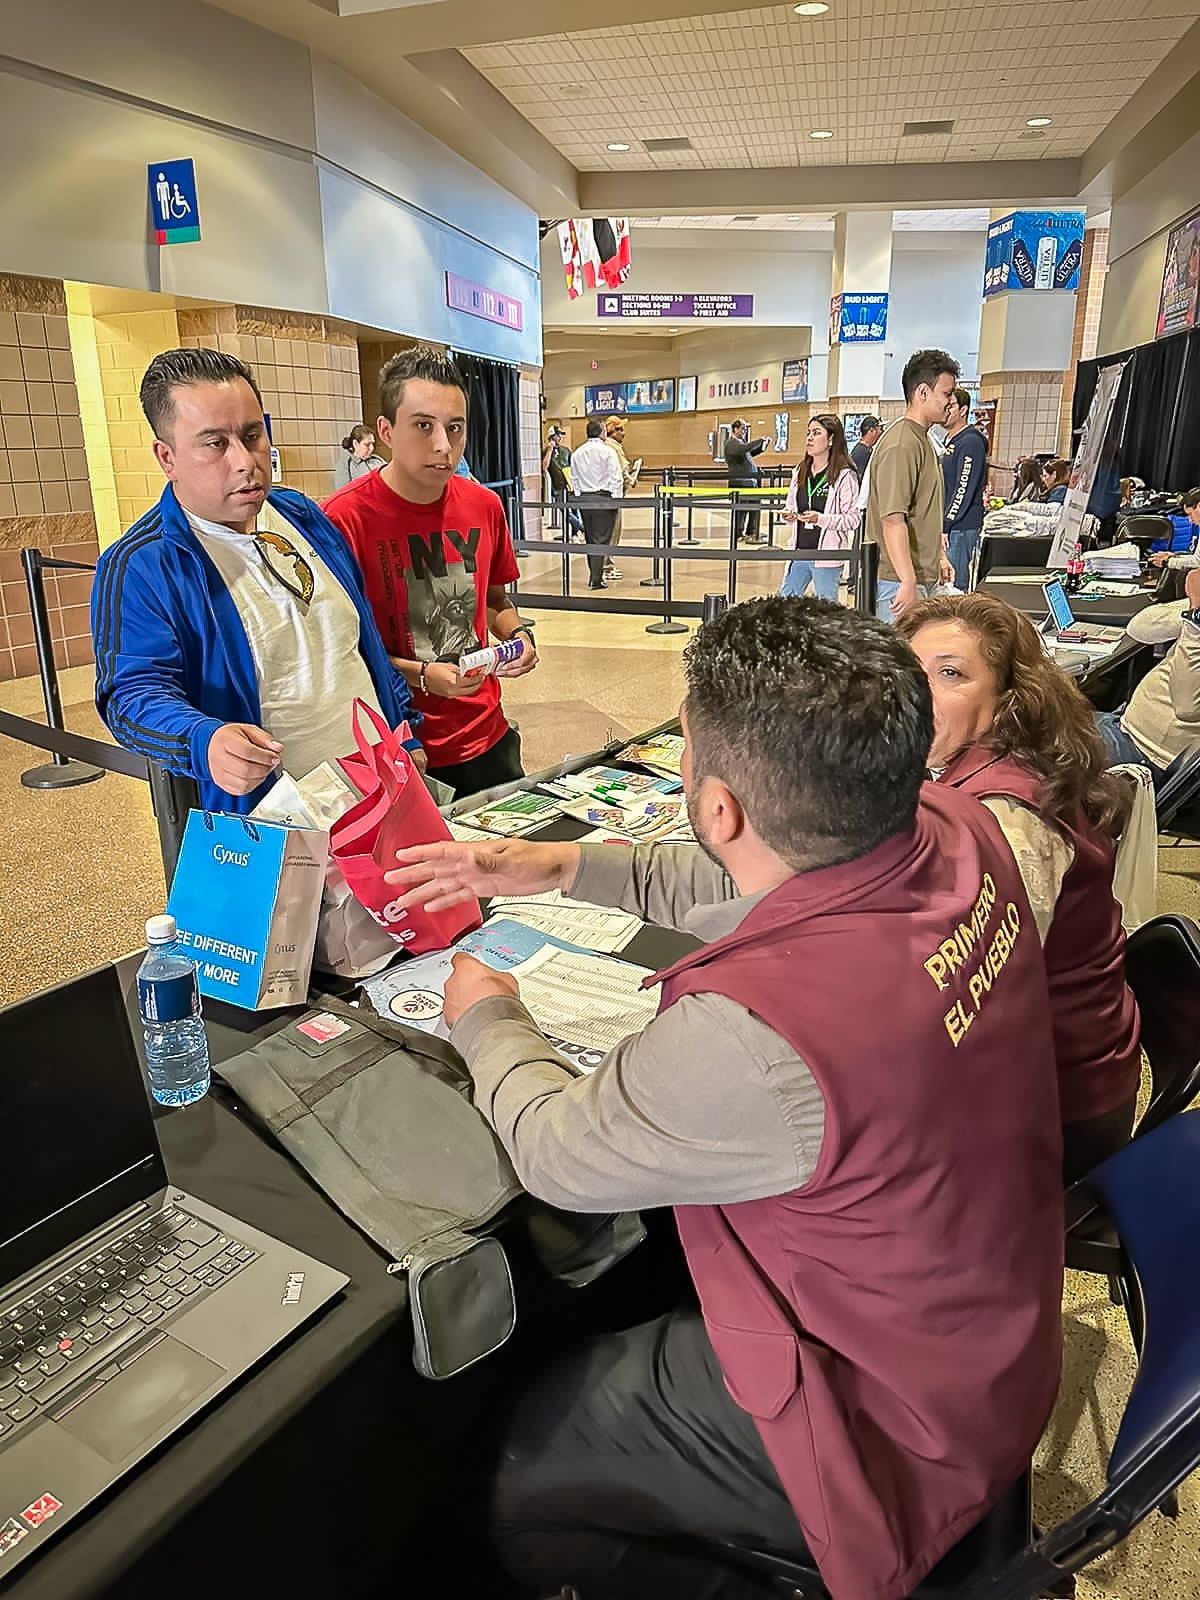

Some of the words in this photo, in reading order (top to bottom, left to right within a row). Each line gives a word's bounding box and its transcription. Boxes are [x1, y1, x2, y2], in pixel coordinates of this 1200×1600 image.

[1056, 251, 1081, 283] ULTRA
[715, 302, 737, 310] OFFICE
[844, 295, 861, 304] BUD
[861, 295, 885, 304] LIGHT
[717, 379, 759, 398] TICKETS
[595, 399, 616, 410] LIGHT
[946, 455, 973, 521] AEROPOSTALE
[407, 527, 481, 580] NY
[213, 844, 249, 867] Cyxus
[923, 872, 996, 992] PRIMERO
[193, 934, 258, 965] DIFFERENT
[203, 964, 241, 986] MORE
[943, 1000, 977, 1048] EL
[968, 902, 1020, 1011] PUEBLO
